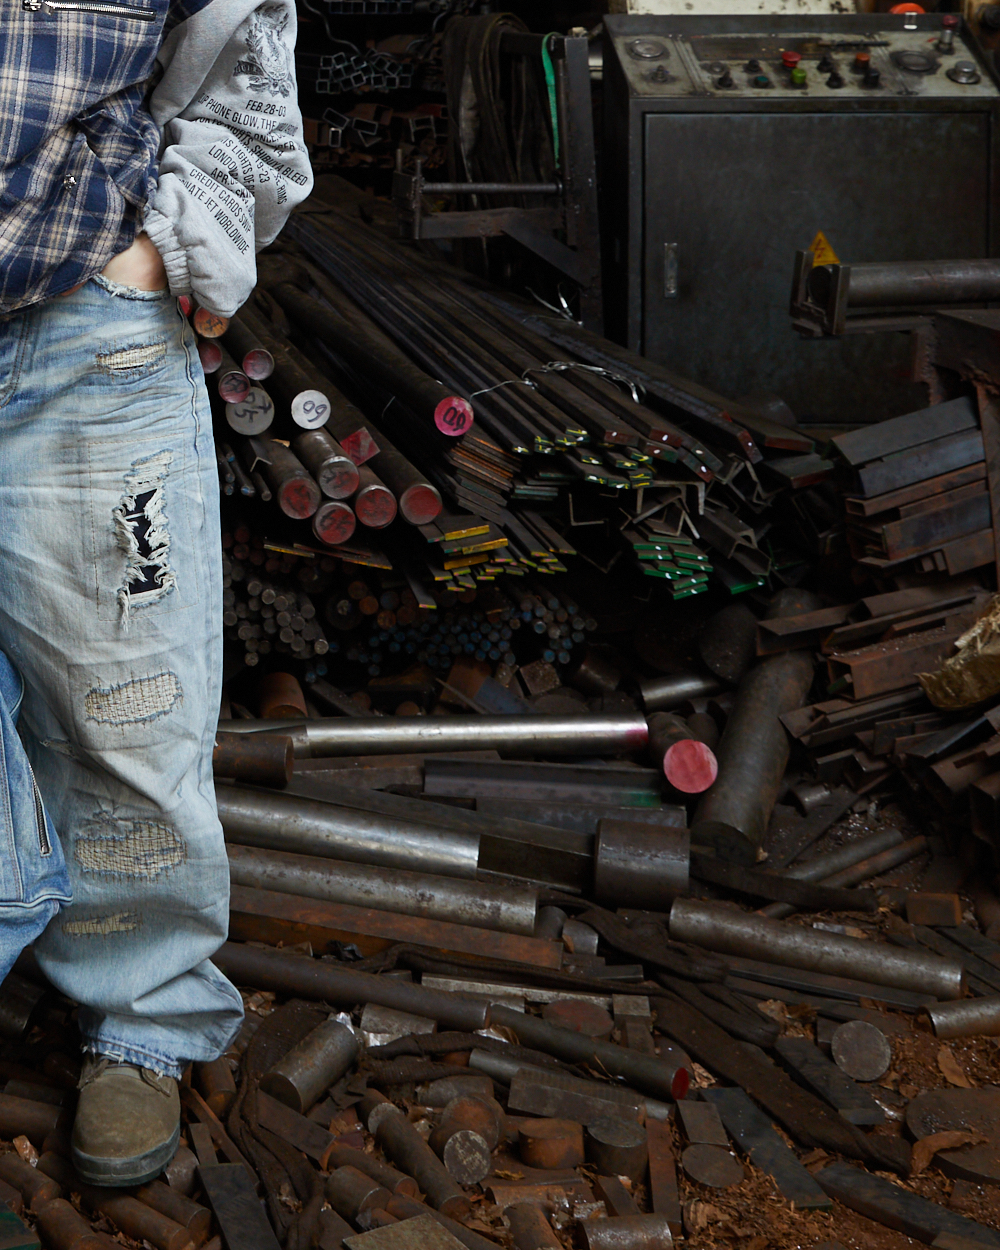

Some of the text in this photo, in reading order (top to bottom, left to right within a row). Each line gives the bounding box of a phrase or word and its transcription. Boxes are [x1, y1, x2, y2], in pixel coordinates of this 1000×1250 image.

[206, 98, 232, 119] PHONE
[231, 144, 253, 173] LIGHTS
[251, 144, 284, 172] SHIBUYA
[281, 166, 308, 187] BLEED
[189, 168, 222, 194] CREDIT
[218, 190, 243, 217] CARDS
[210, 167, 231, 187] APR.
[203, 196, 219, 213] JET
[214, 209, 250, 255] WORLDWIDE
